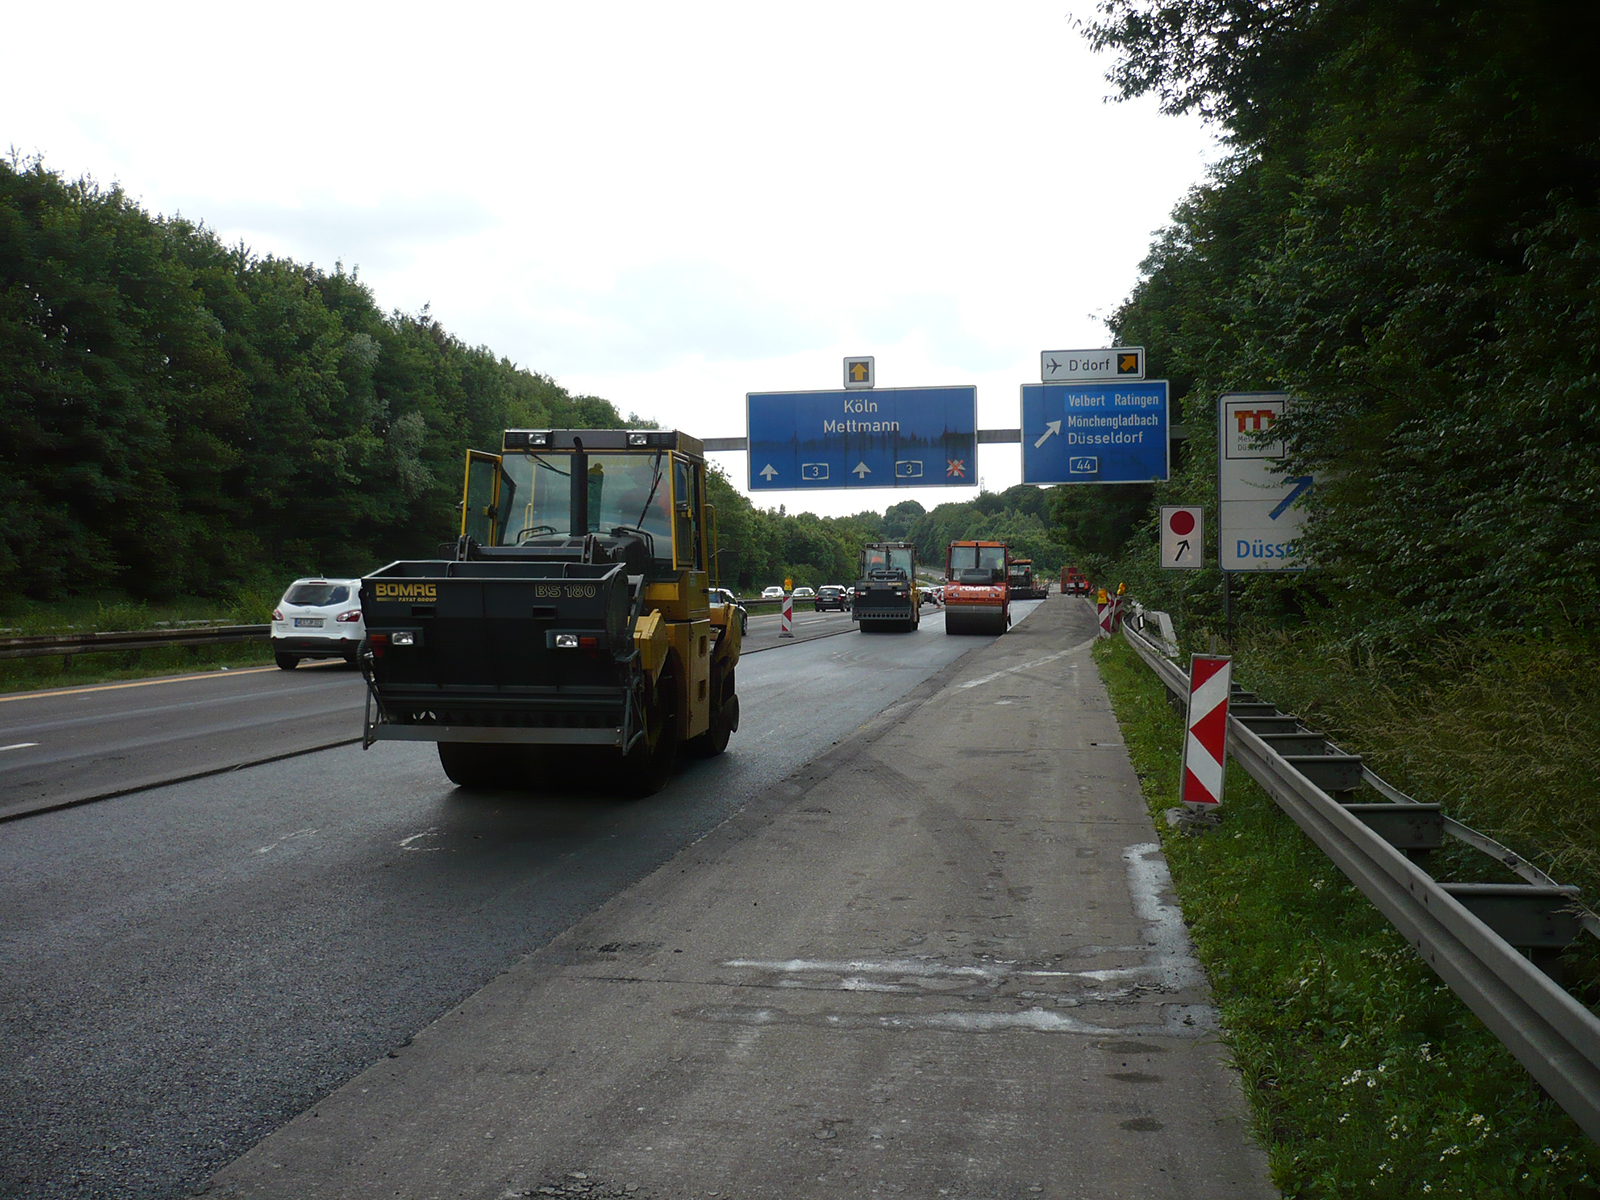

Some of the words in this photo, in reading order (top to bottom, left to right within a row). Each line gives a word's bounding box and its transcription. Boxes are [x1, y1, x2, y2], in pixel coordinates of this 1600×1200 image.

[1069, 358, 1110, 371] D'dorf
[844, 399, 878, 413] Köln
[1068, 394, 1105, 407] Velbert
[1114, 393, 1159, 408] Ratingen
[823, 419, 900, 433] Mettmann
[1068, 414, 1158, 429] Mönchengladbach
[1068, 431, 1143, 445] Düsseldorf
[812, 466, 819, 477] 3
[906, 464, 913, 474] 3
[1076, 459, 1091, 470] 44
[1236, 540, 1304, 558] Düsse
[375, 583, 437, 596] BOMAG
[535, 583, 561, 598] BS
[564, 583, 596, 598] 180
